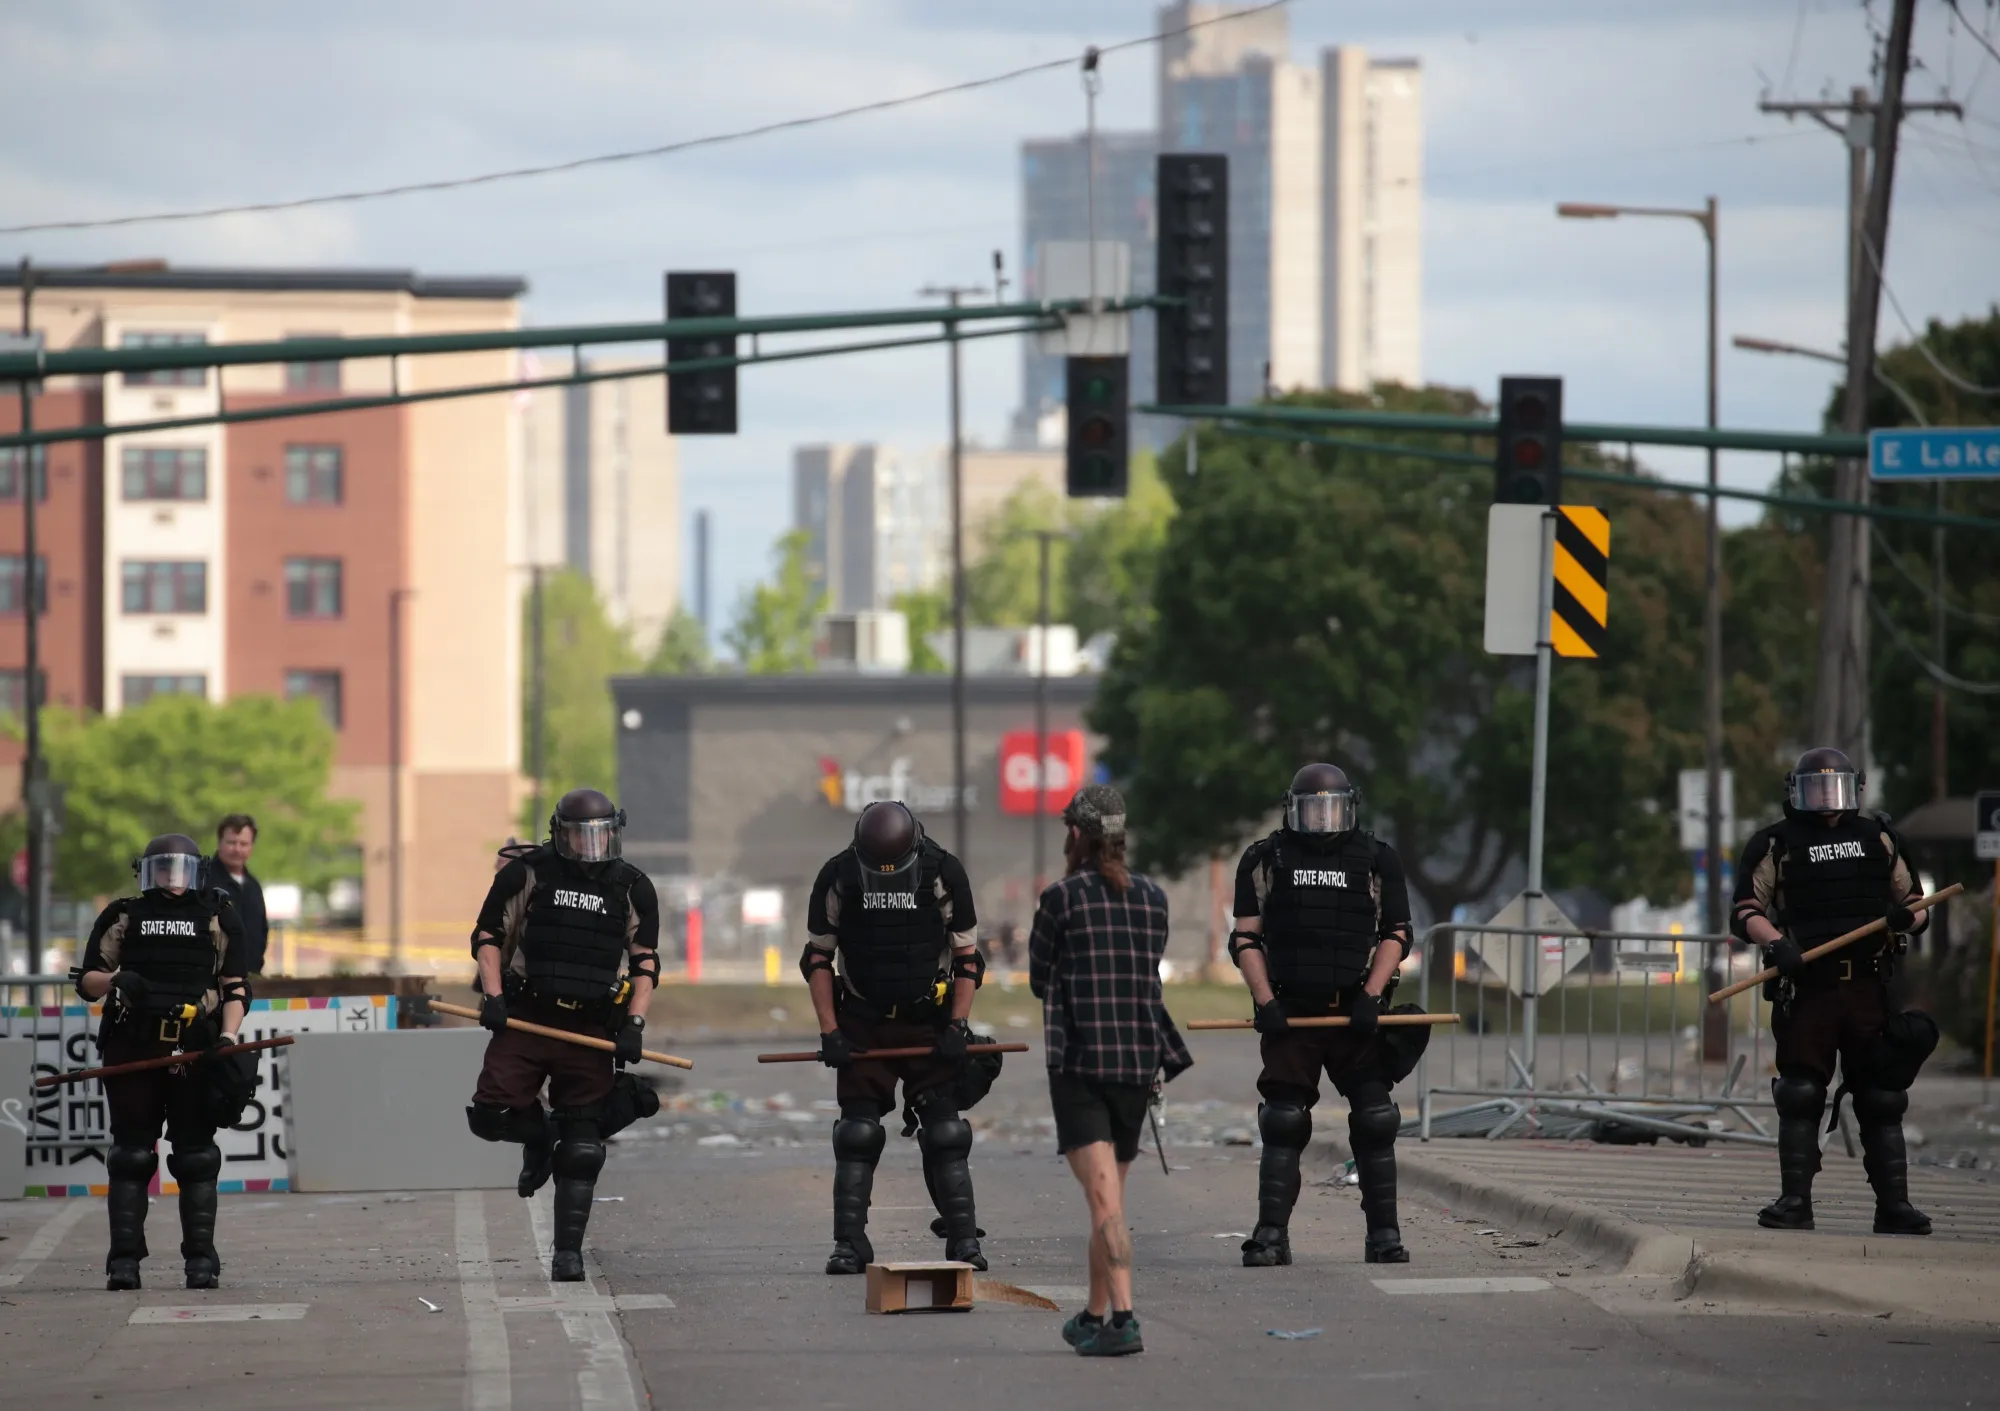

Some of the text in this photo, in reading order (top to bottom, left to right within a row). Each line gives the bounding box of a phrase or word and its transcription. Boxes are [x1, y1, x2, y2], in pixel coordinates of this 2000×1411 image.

[1882, 440, 2000, 469] E Lake
[1808, 841, 1865, 863] STATE PATROL
[880, 864, 895, 872] 232
[1293, 869, 1348, 888] STATE PATROL
[554, 889, 579, 908] STATE
[863, 892, 917, 909] STATE PATROL
[141, 920, 196, 937] STATE PATROL
[66, 1032, 106, 1166] GEEK
